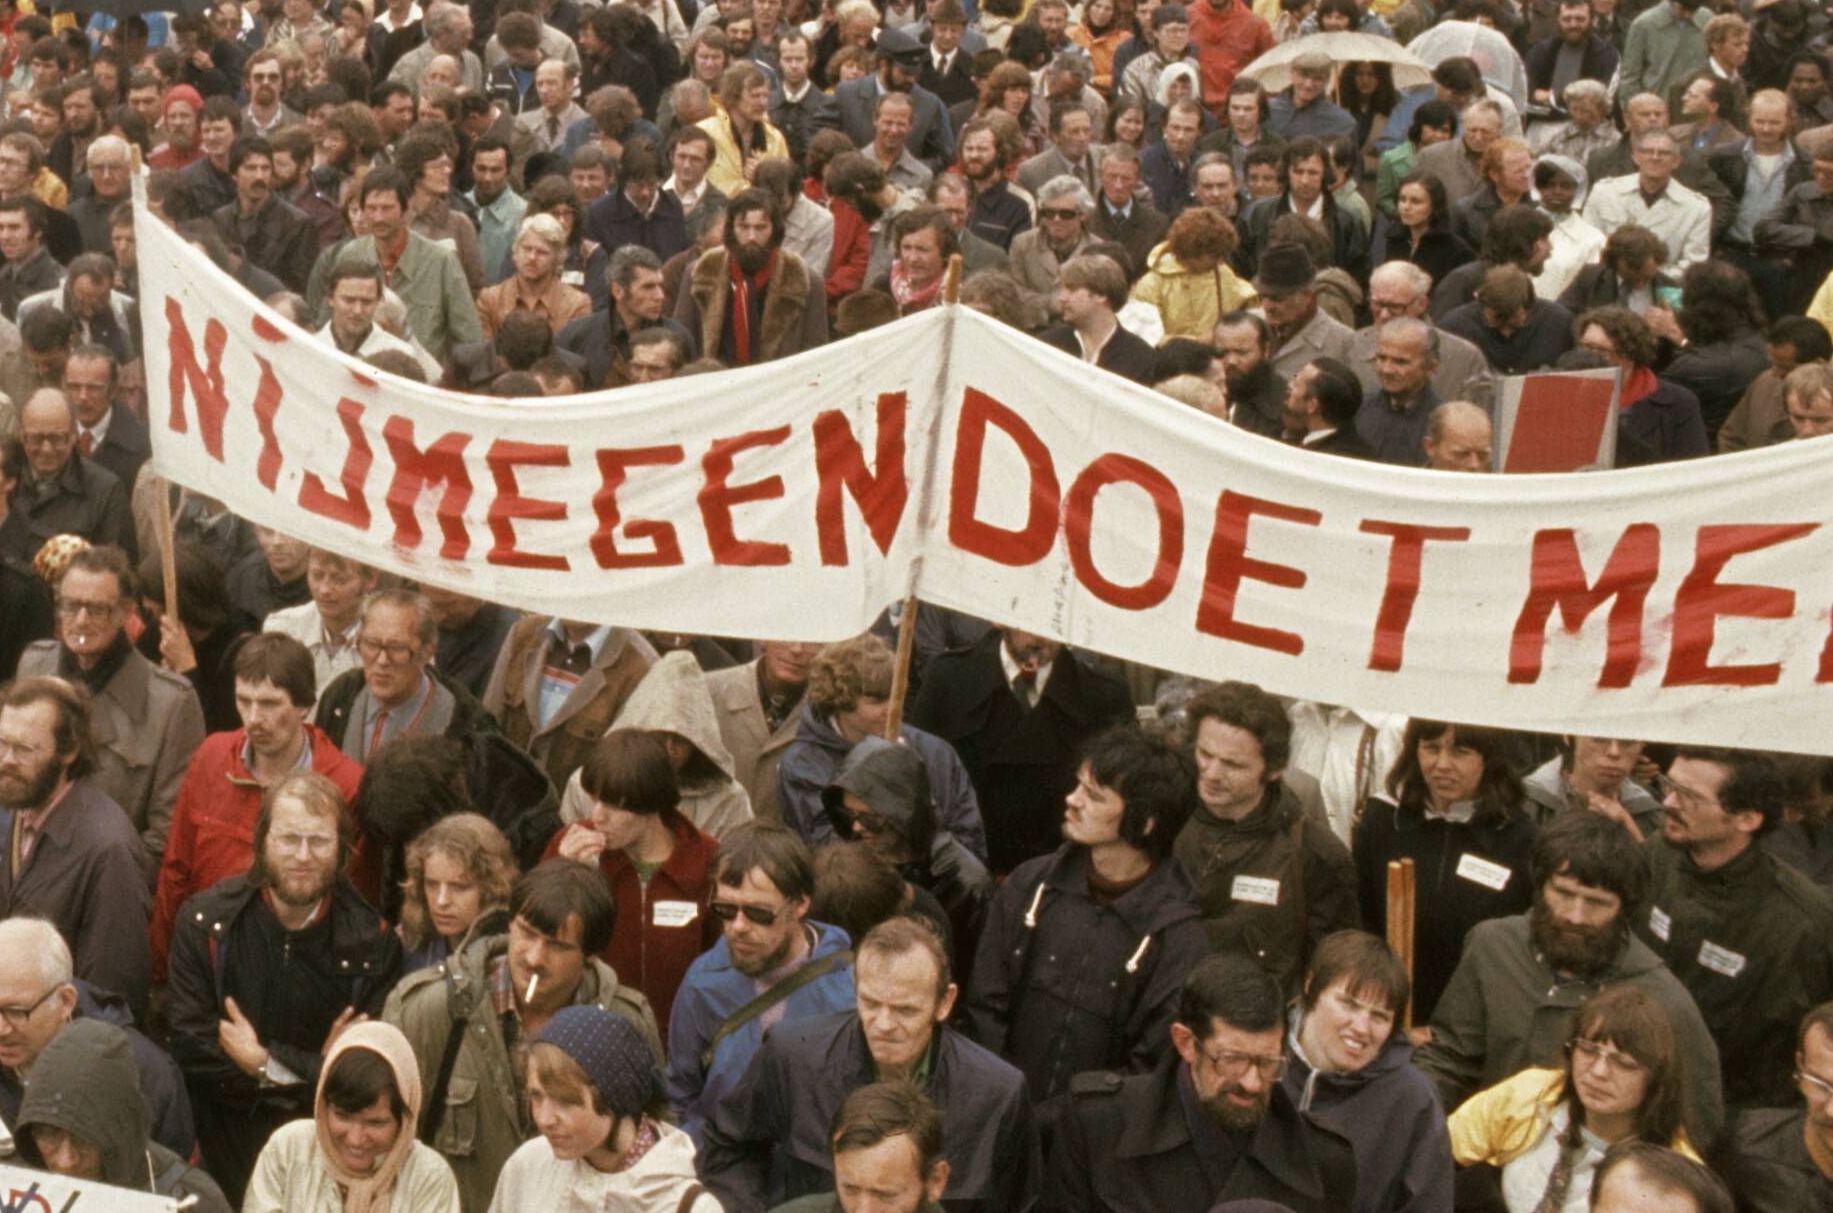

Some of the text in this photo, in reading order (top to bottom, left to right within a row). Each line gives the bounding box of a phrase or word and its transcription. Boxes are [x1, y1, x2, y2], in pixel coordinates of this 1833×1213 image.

[164, 294, 910, 570] NIJMEGEN
[947, 384, 1833, 689] DOET ME
